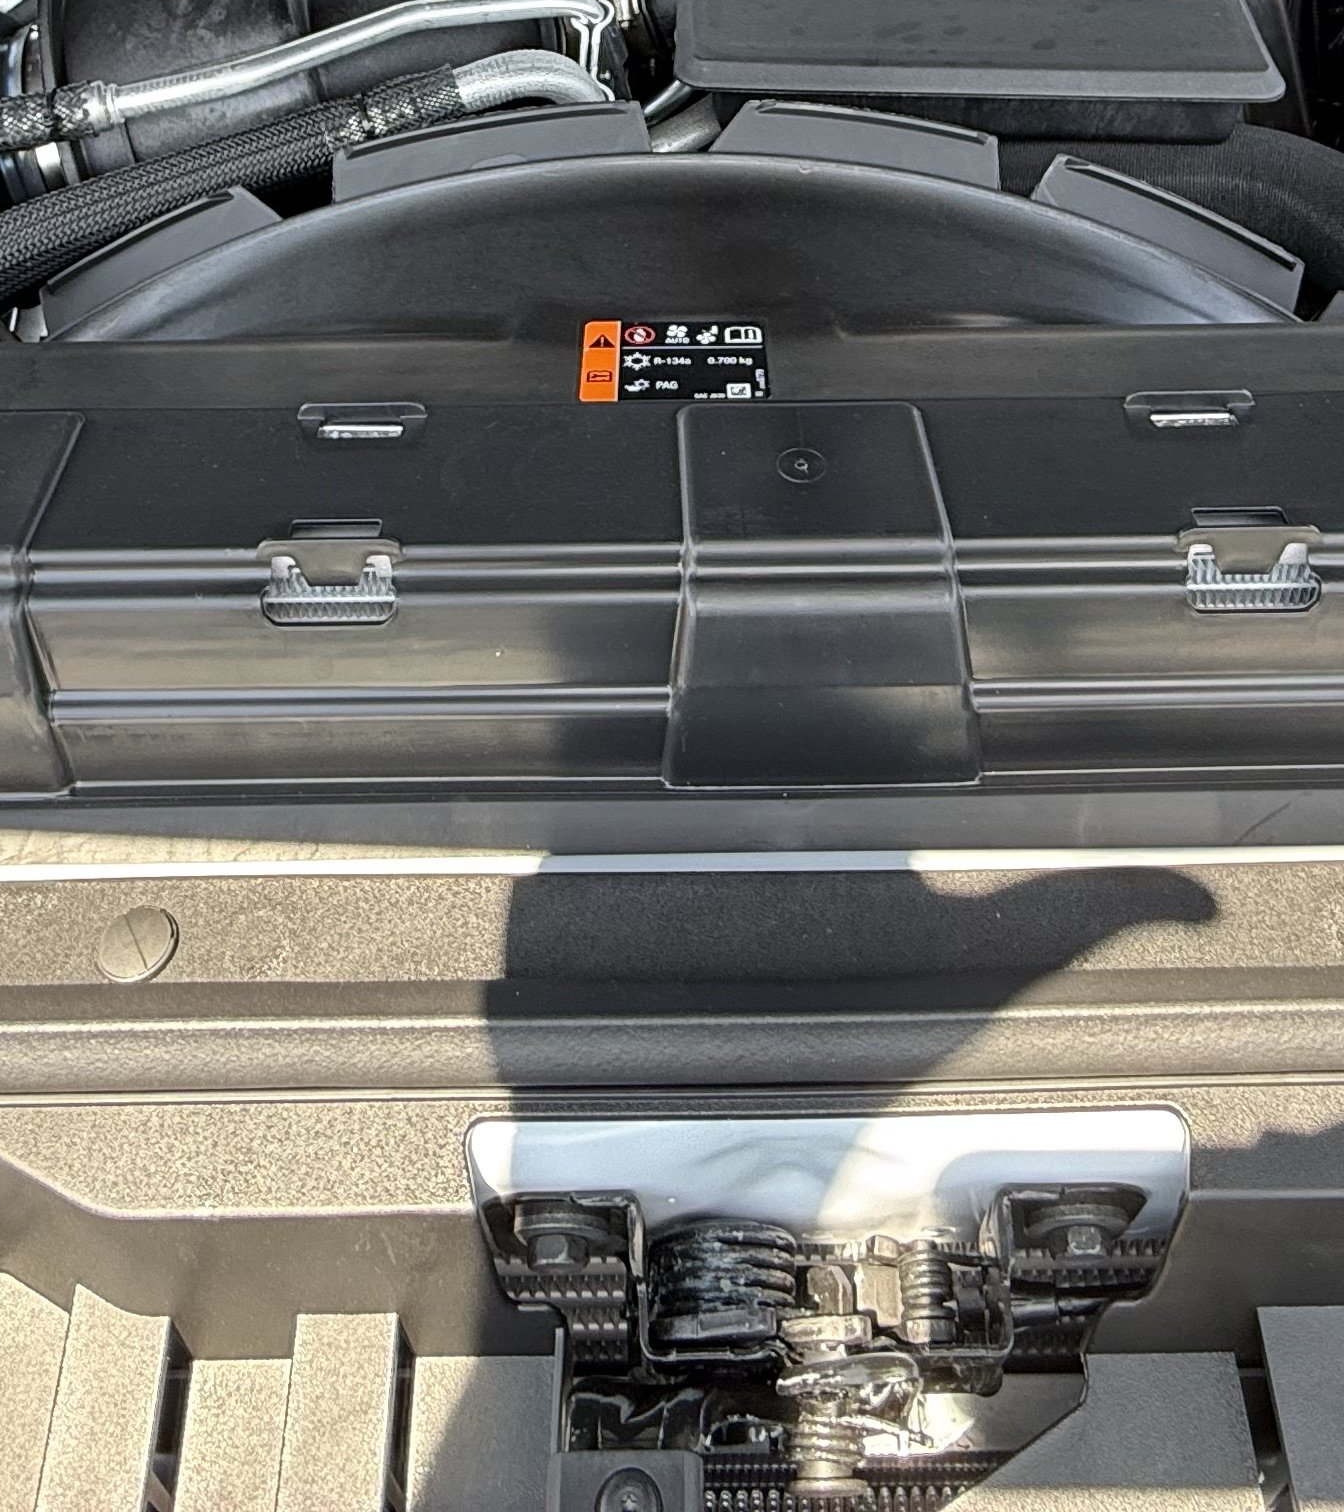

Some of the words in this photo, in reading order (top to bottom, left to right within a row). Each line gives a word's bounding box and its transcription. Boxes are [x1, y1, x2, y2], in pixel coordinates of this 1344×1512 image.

[653, 357, 692, 365] R-134a
[739, 356, 753, 366] kg
[656, 380, 679, 390] PAG
